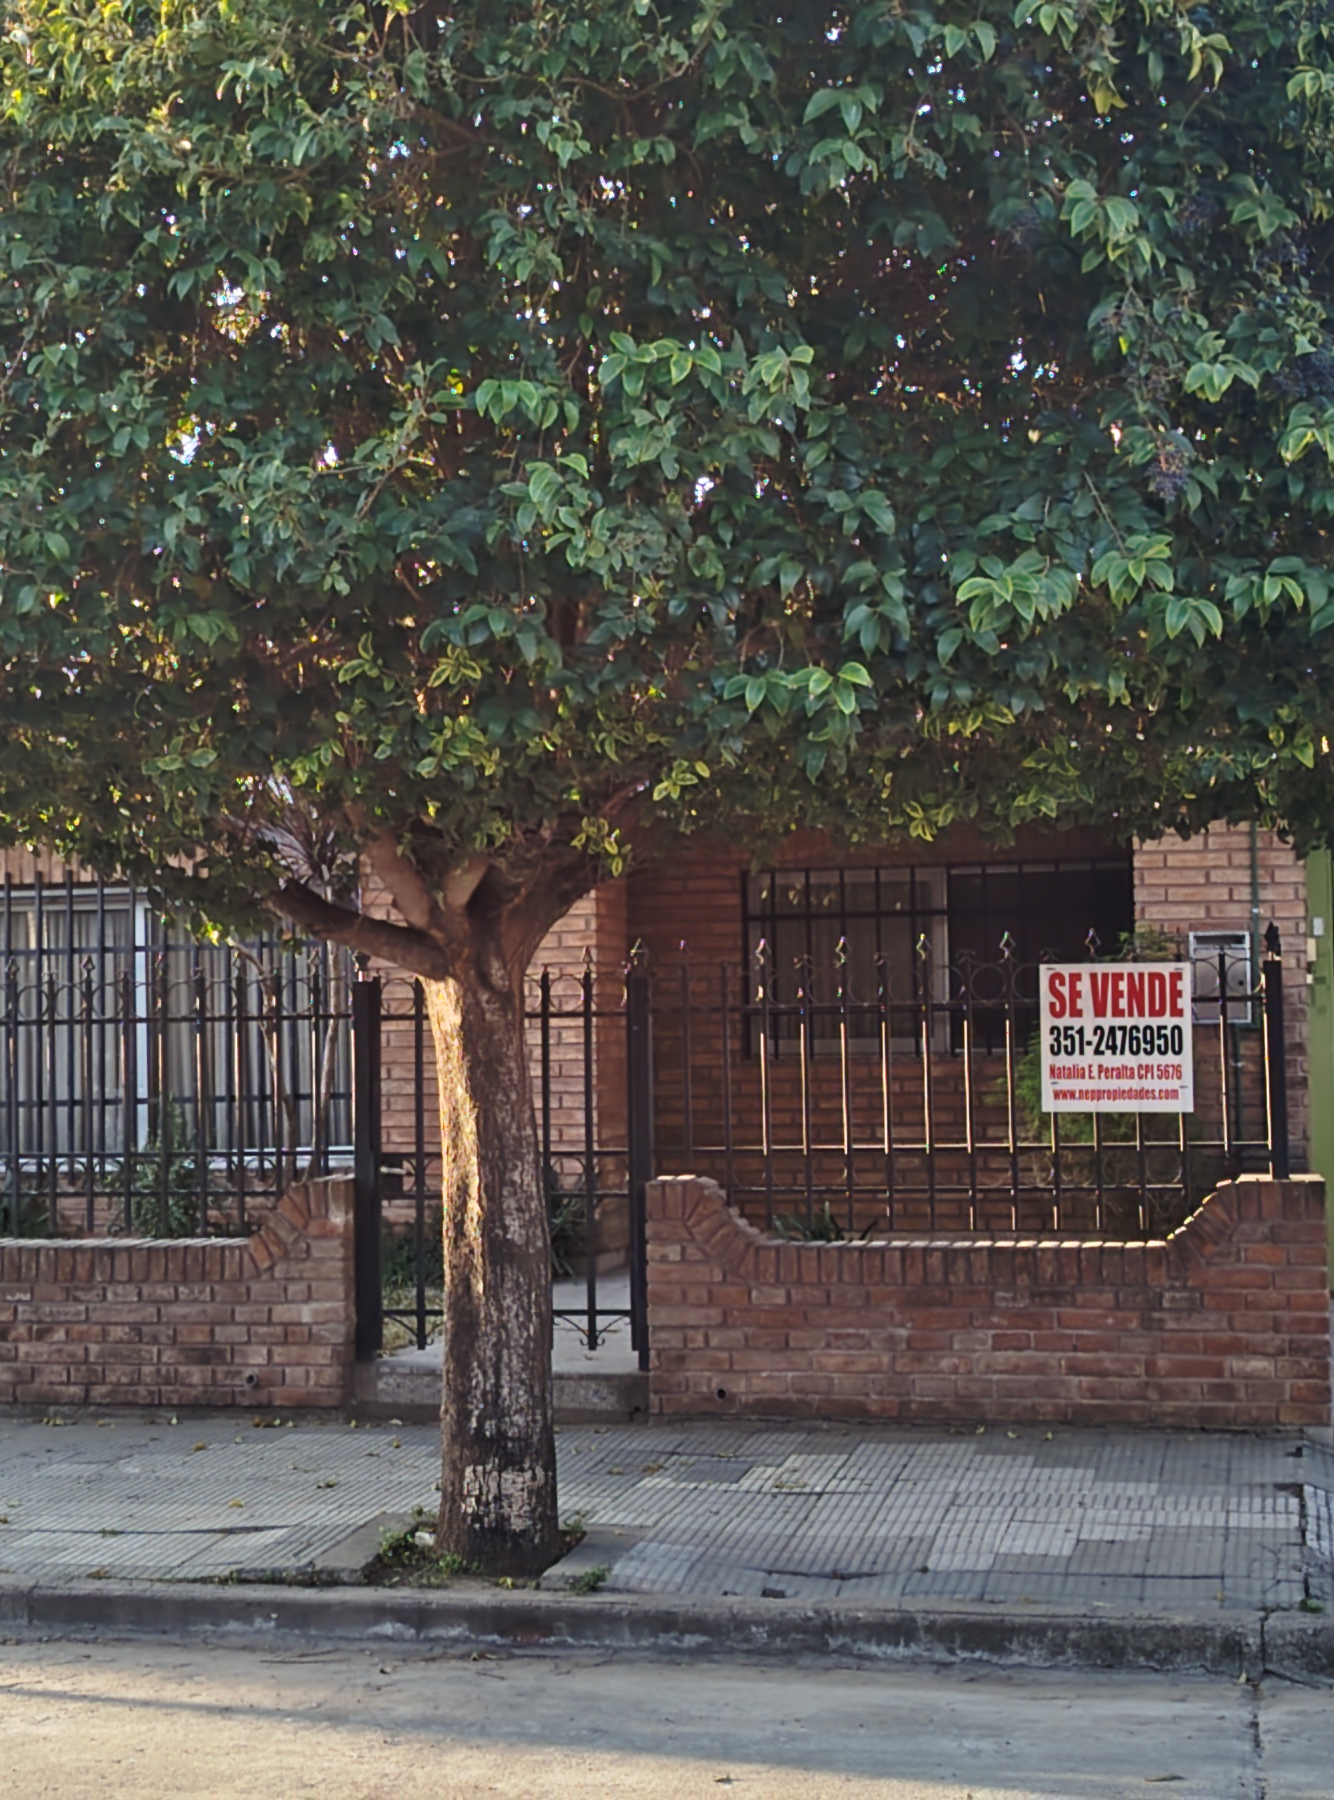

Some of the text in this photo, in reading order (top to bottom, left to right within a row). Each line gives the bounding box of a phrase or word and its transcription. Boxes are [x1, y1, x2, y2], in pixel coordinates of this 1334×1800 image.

[1048, 972, 1184, 1018] SE VENDE
[1049, 1025, 1183, 1056] 351-2476950
[1049, 1064, 1182, 1080] Natalia E. Peralta CPI 5676
[1053, 1087, 1180, 1102] www.neppropiedades.com
